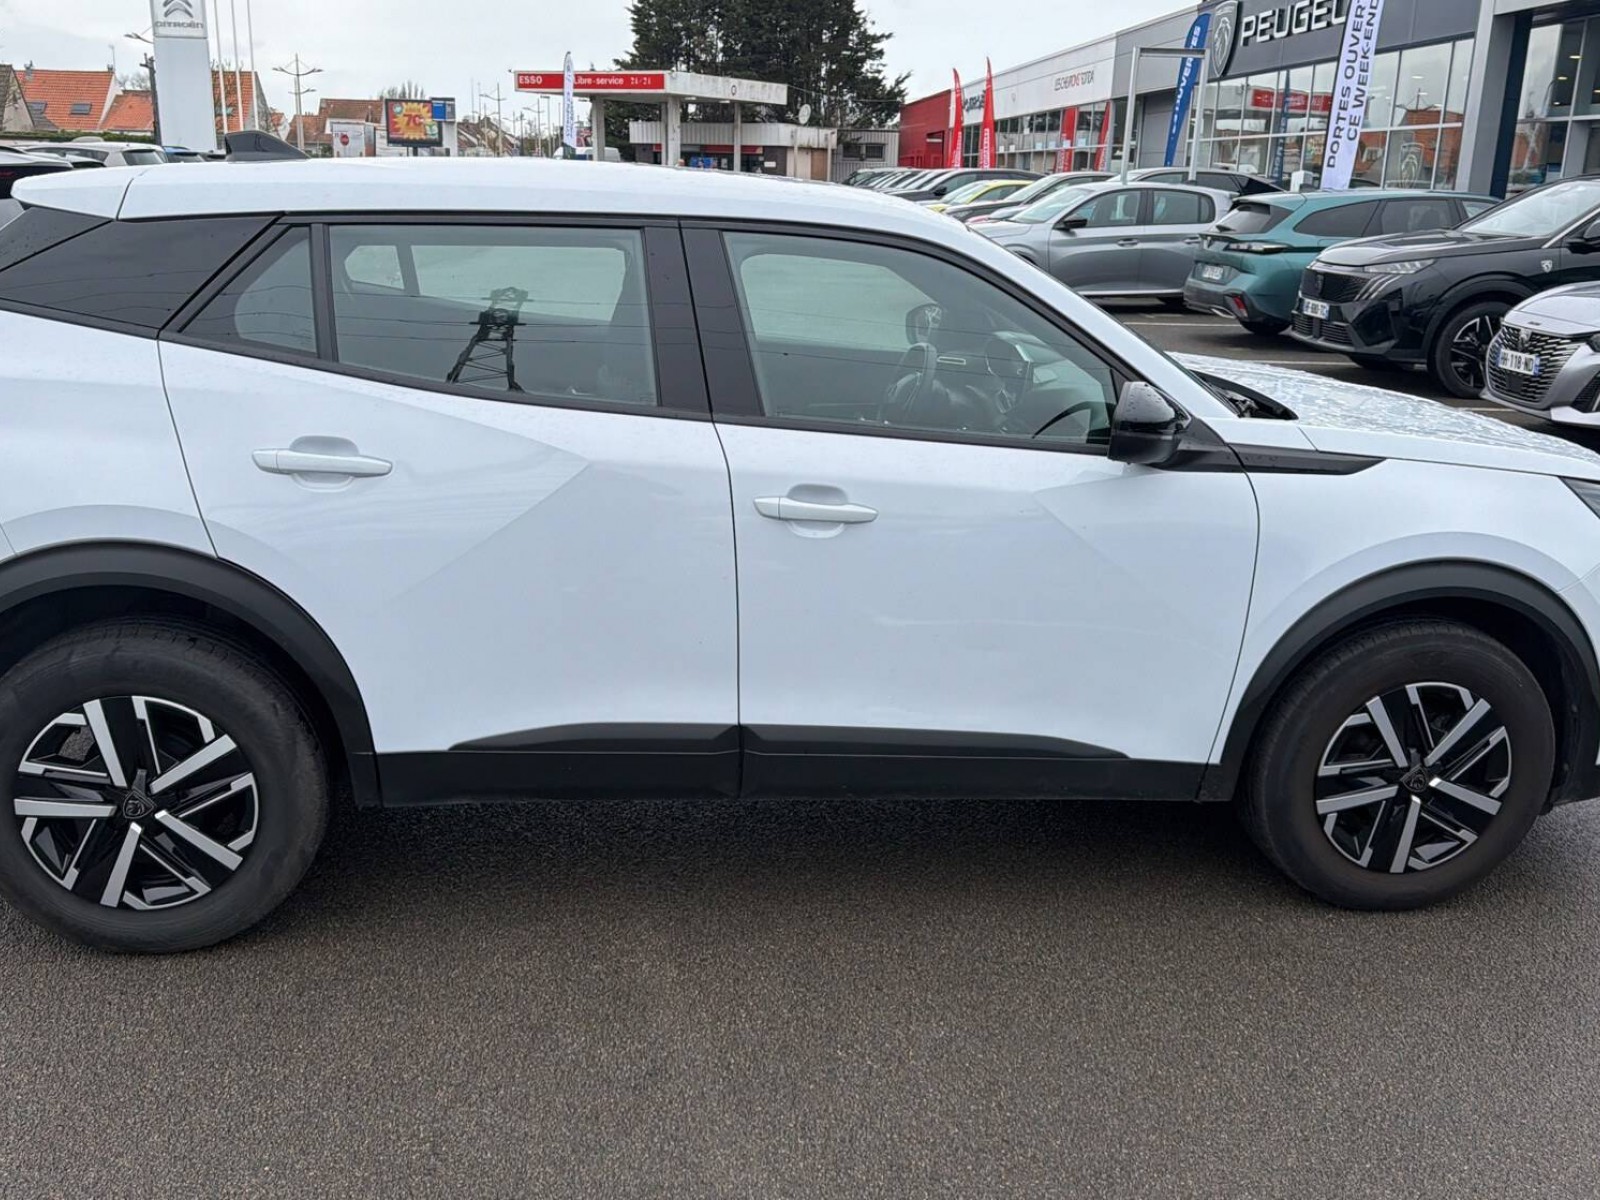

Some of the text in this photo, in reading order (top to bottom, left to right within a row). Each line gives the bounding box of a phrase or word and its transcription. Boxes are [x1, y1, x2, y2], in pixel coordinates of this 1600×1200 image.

[519, 75, 543, 85] ESSO
[1176, 25, 1201, 111] OUVERES
[1344, 0, 1366, 80] OUVER
[1347, 0, 1379, 141] CE WEEK-END
